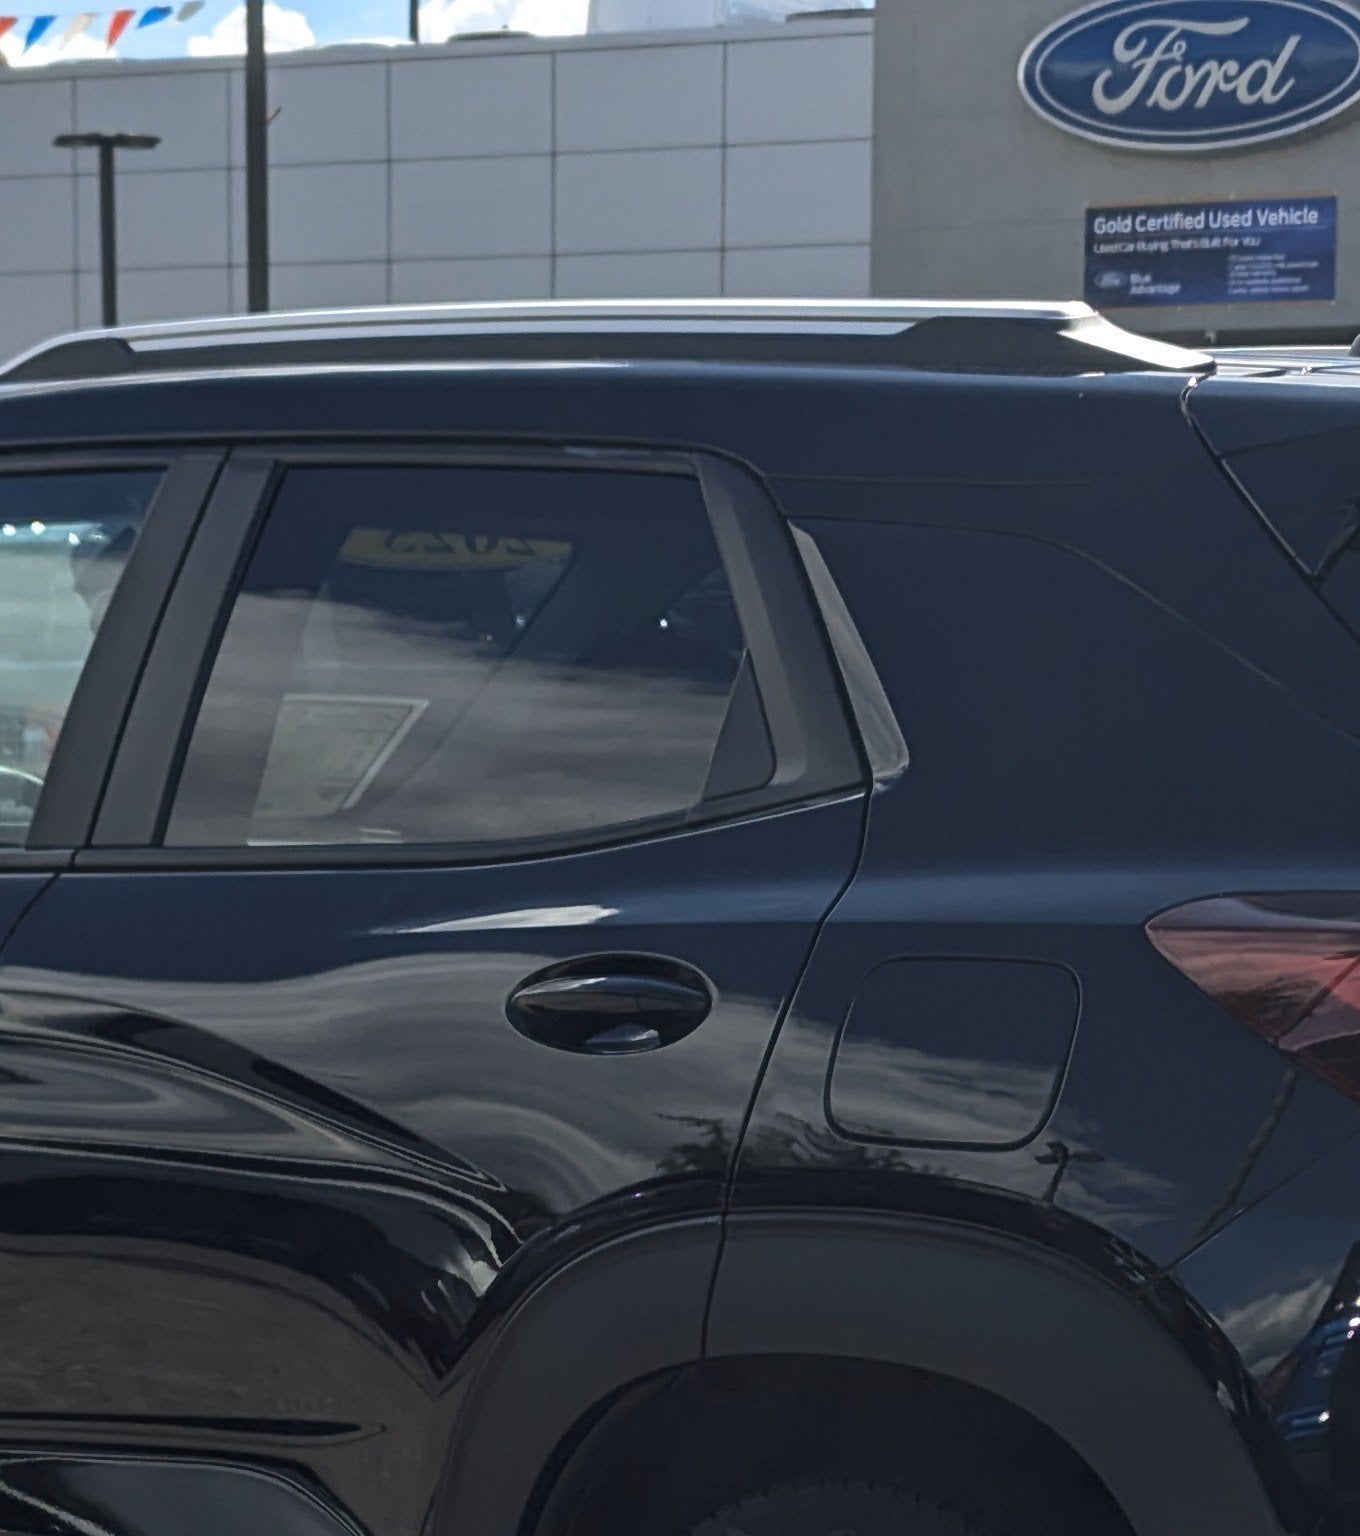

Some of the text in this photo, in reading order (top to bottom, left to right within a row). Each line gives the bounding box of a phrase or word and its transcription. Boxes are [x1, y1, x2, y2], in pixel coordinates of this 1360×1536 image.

[1092, 16, 1303, 115] Ford
[1093, 204, 1319, 235] Gold Certified Used Vehicle
